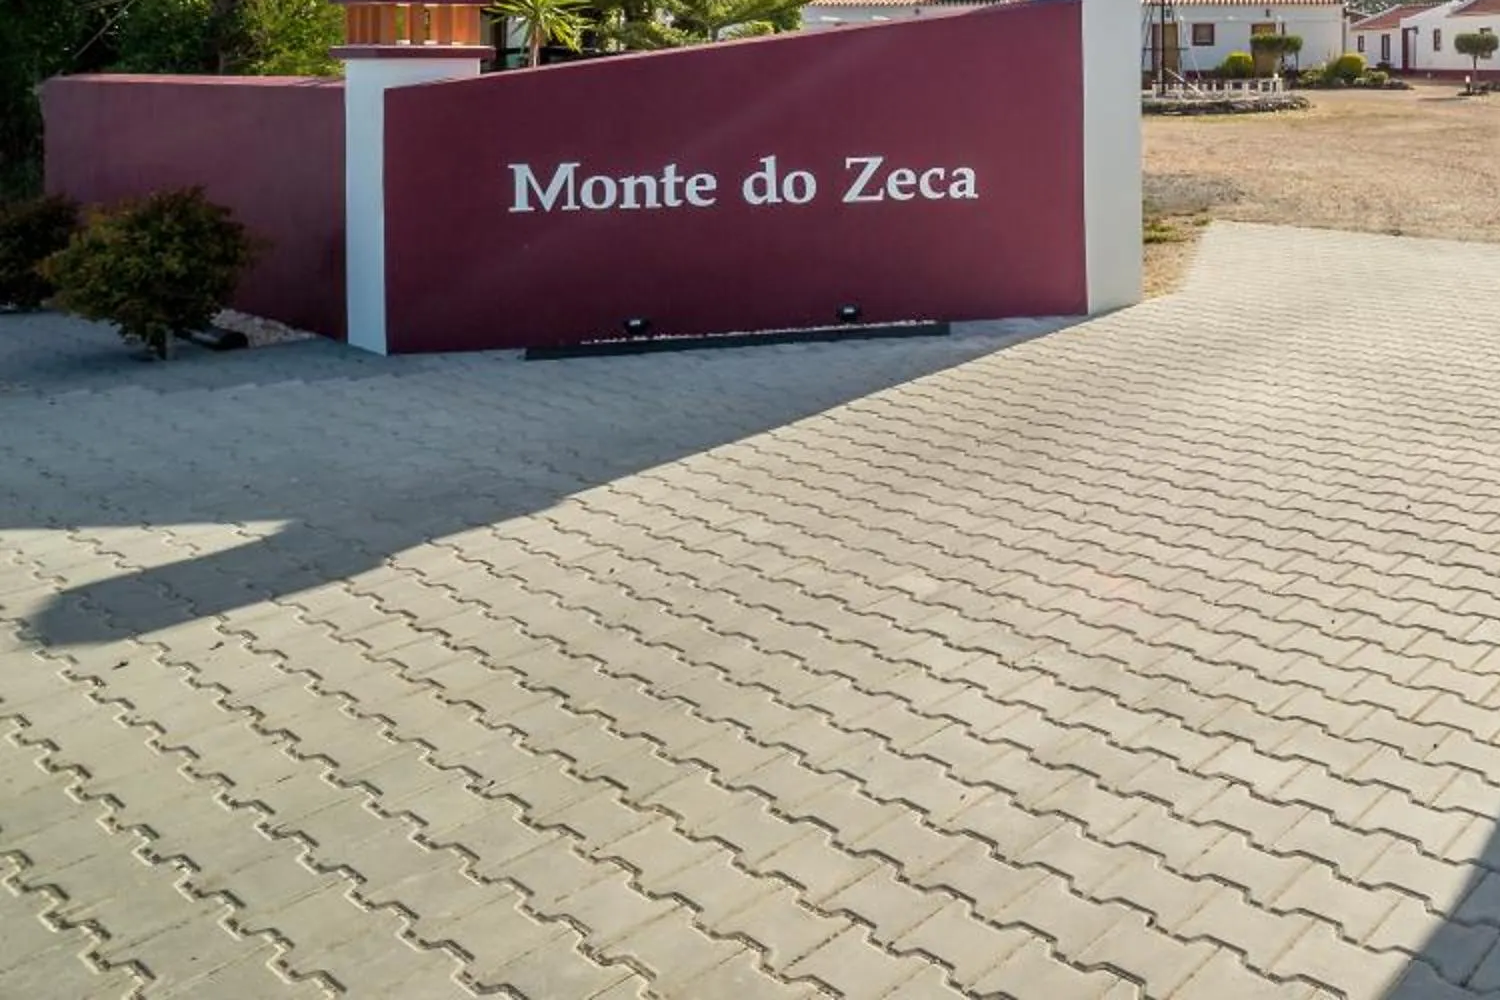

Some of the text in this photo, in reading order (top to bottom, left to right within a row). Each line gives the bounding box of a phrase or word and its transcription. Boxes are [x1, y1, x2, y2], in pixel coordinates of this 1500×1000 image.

[507, 155, 979, 212] Monte do Zeca
